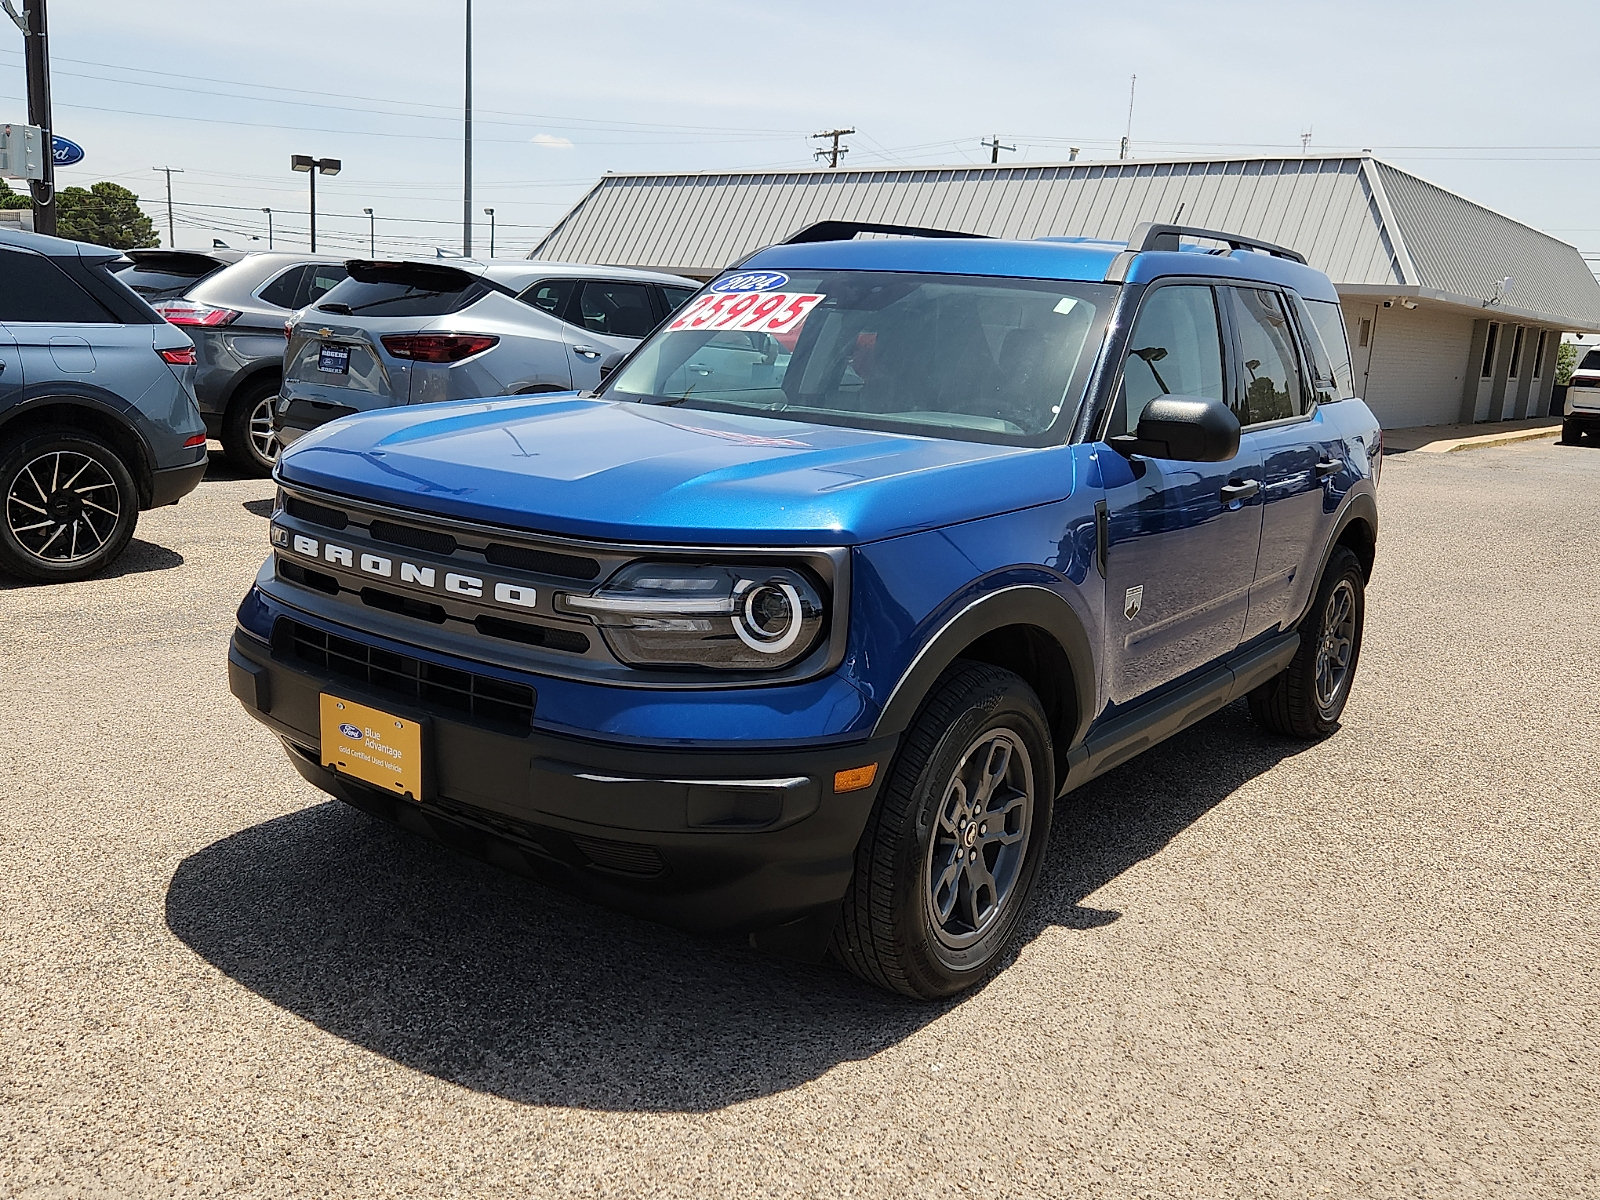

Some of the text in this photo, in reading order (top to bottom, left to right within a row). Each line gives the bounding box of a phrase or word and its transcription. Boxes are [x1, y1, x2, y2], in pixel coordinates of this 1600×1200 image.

[718, 275, 782, 291] 2024
[670, 294, 820, 329] 25995
[293, 534, 537, 608] BRONCO
[342, 724, 360, 738] Ford
[364, 727, 381, 741] Blue
[364, 738, 403, 759] Advantage
[338, 745, 403, 774] Gold Certified Used Vehicle
